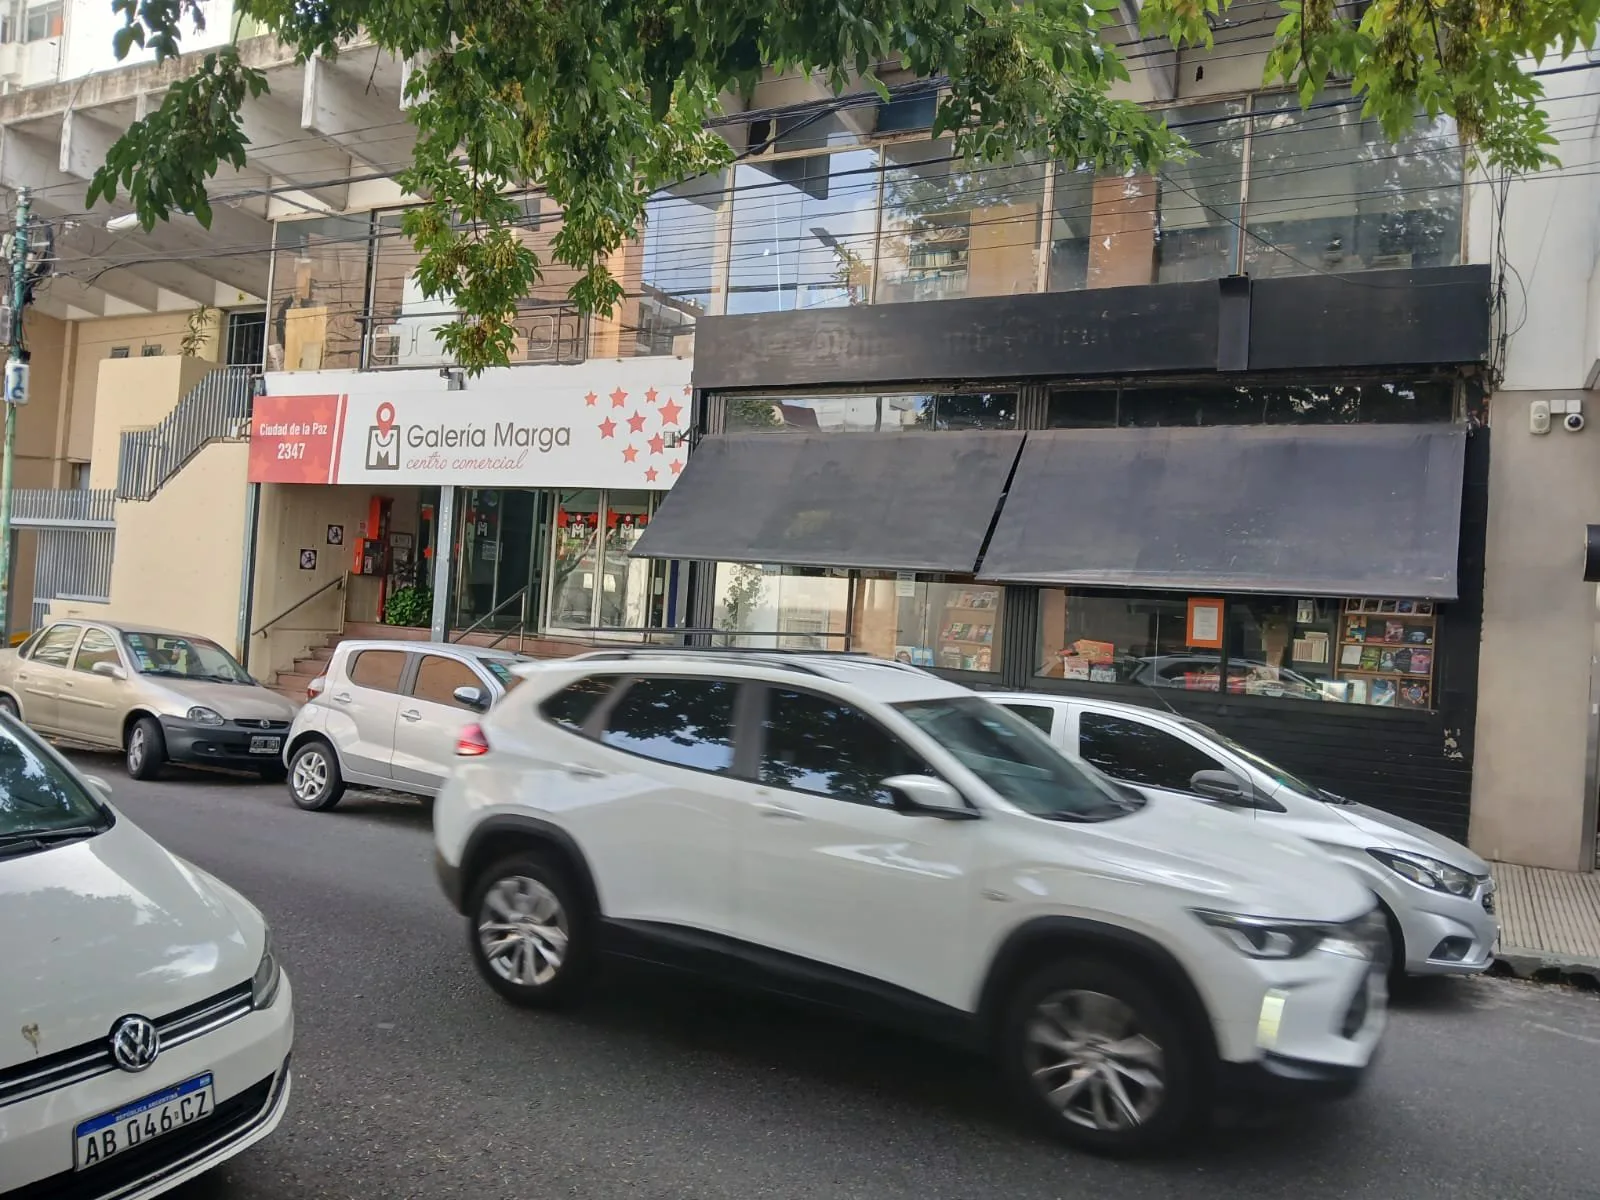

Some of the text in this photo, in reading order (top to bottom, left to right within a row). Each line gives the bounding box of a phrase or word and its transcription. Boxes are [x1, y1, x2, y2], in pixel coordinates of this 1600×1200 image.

[259, 422, 328, 436] Ciudad de la Paz
[407, 422, 571, 453] Galería Marga
[277, 442, 306, 460] 2347
[406, 449, 529, 470] centro comercial
[85, 1090, 209, 1165] AB 046 CZ
